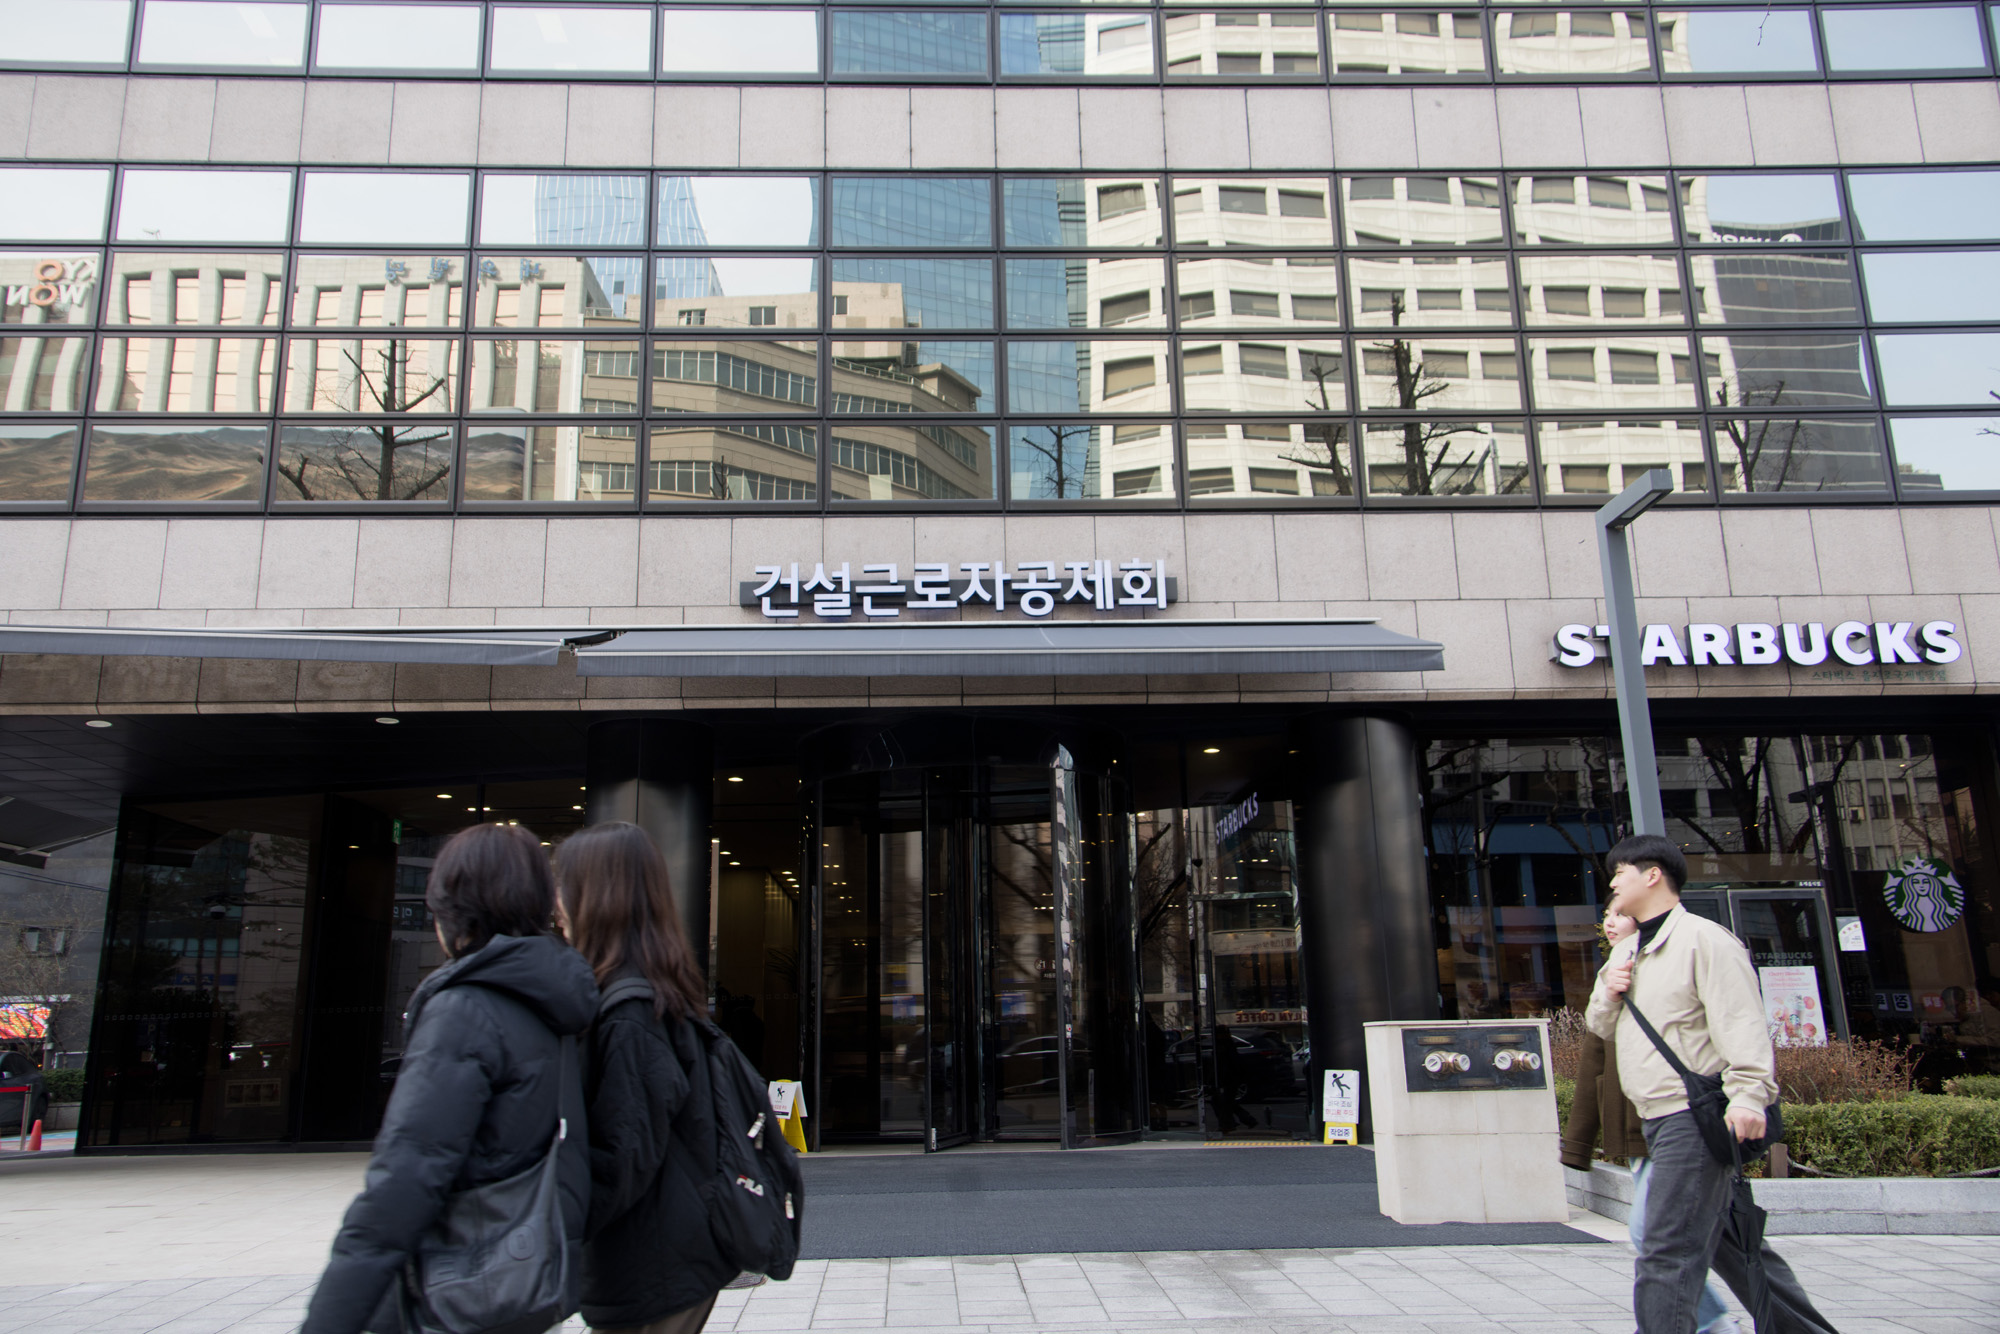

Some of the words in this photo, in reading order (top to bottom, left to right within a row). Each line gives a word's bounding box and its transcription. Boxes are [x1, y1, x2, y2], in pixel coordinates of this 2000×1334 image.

[753, 558, 1167, 617] 건설근로자공제회
[1812, 670, 1855, 681] 스타벅스
[1216, 792, 1259, 845] STARBUCKS
[1755, 952, 1813, 960] STARBUCKS
[1330, 1129, 1350, 1137] 작업중
[736, 1175, 764, 1197] FILA
